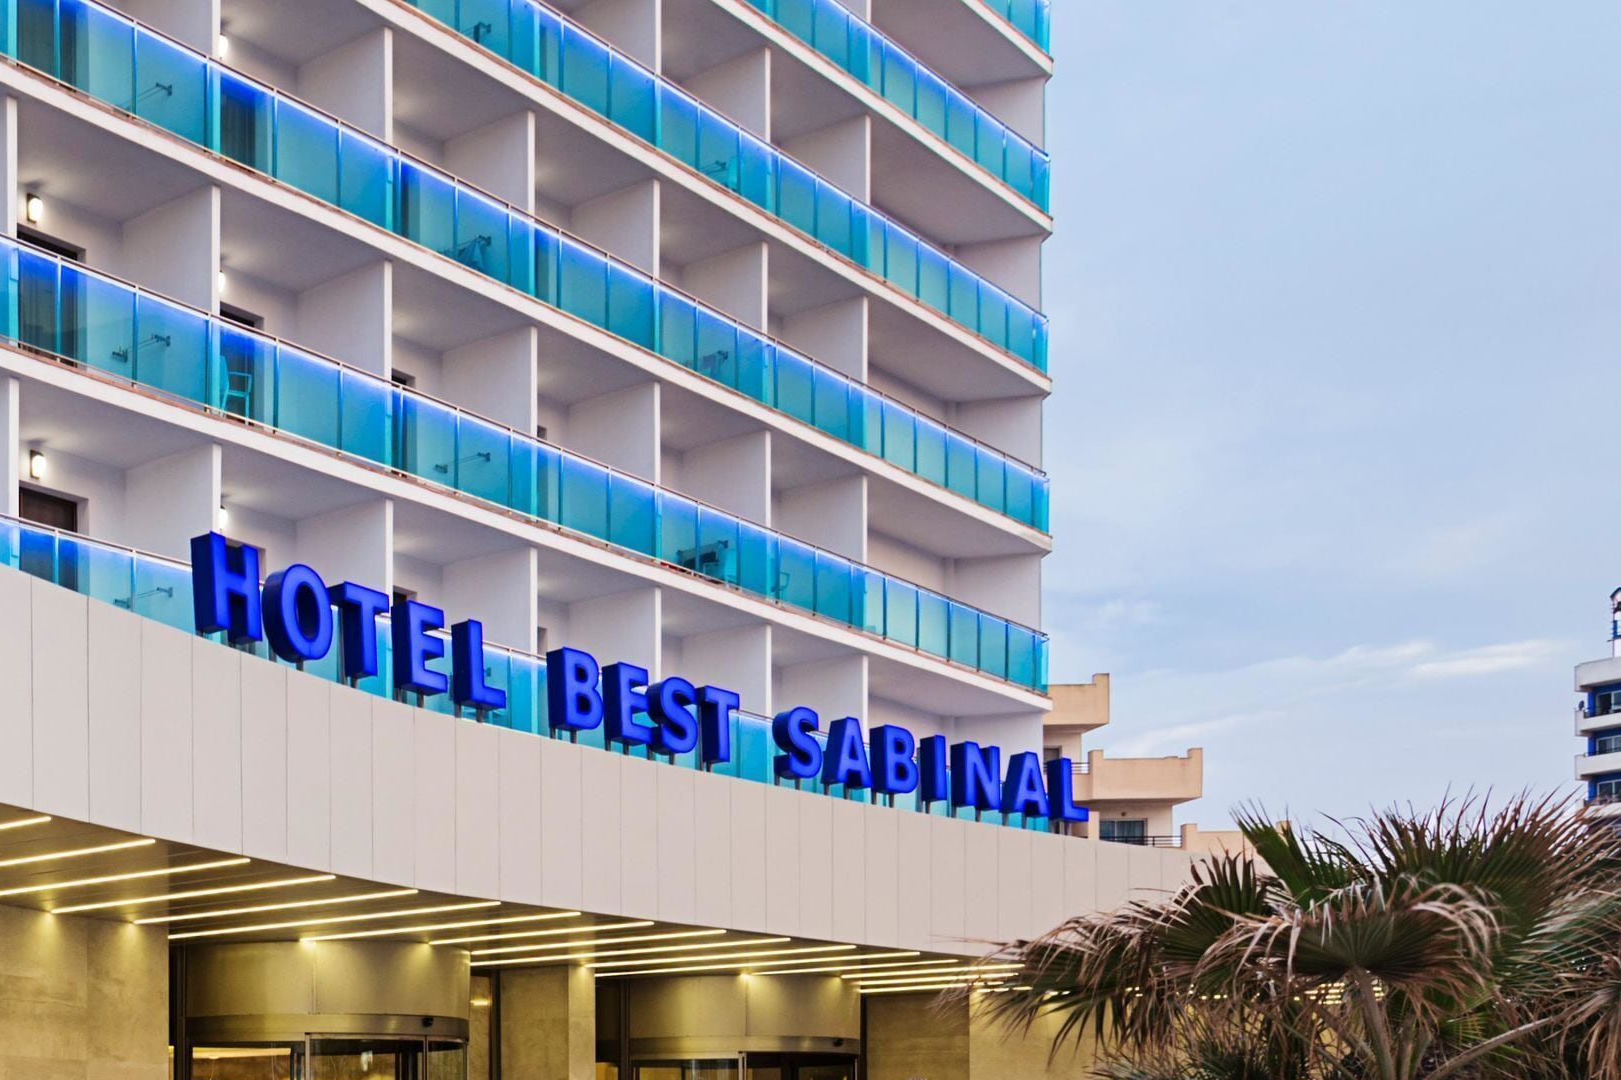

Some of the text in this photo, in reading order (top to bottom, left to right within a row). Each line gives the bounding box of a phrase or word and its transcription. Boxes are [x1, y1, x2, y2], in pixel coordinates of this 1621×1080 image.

[191, 531, 1089, 822] HOTEL BEST SABINAL
